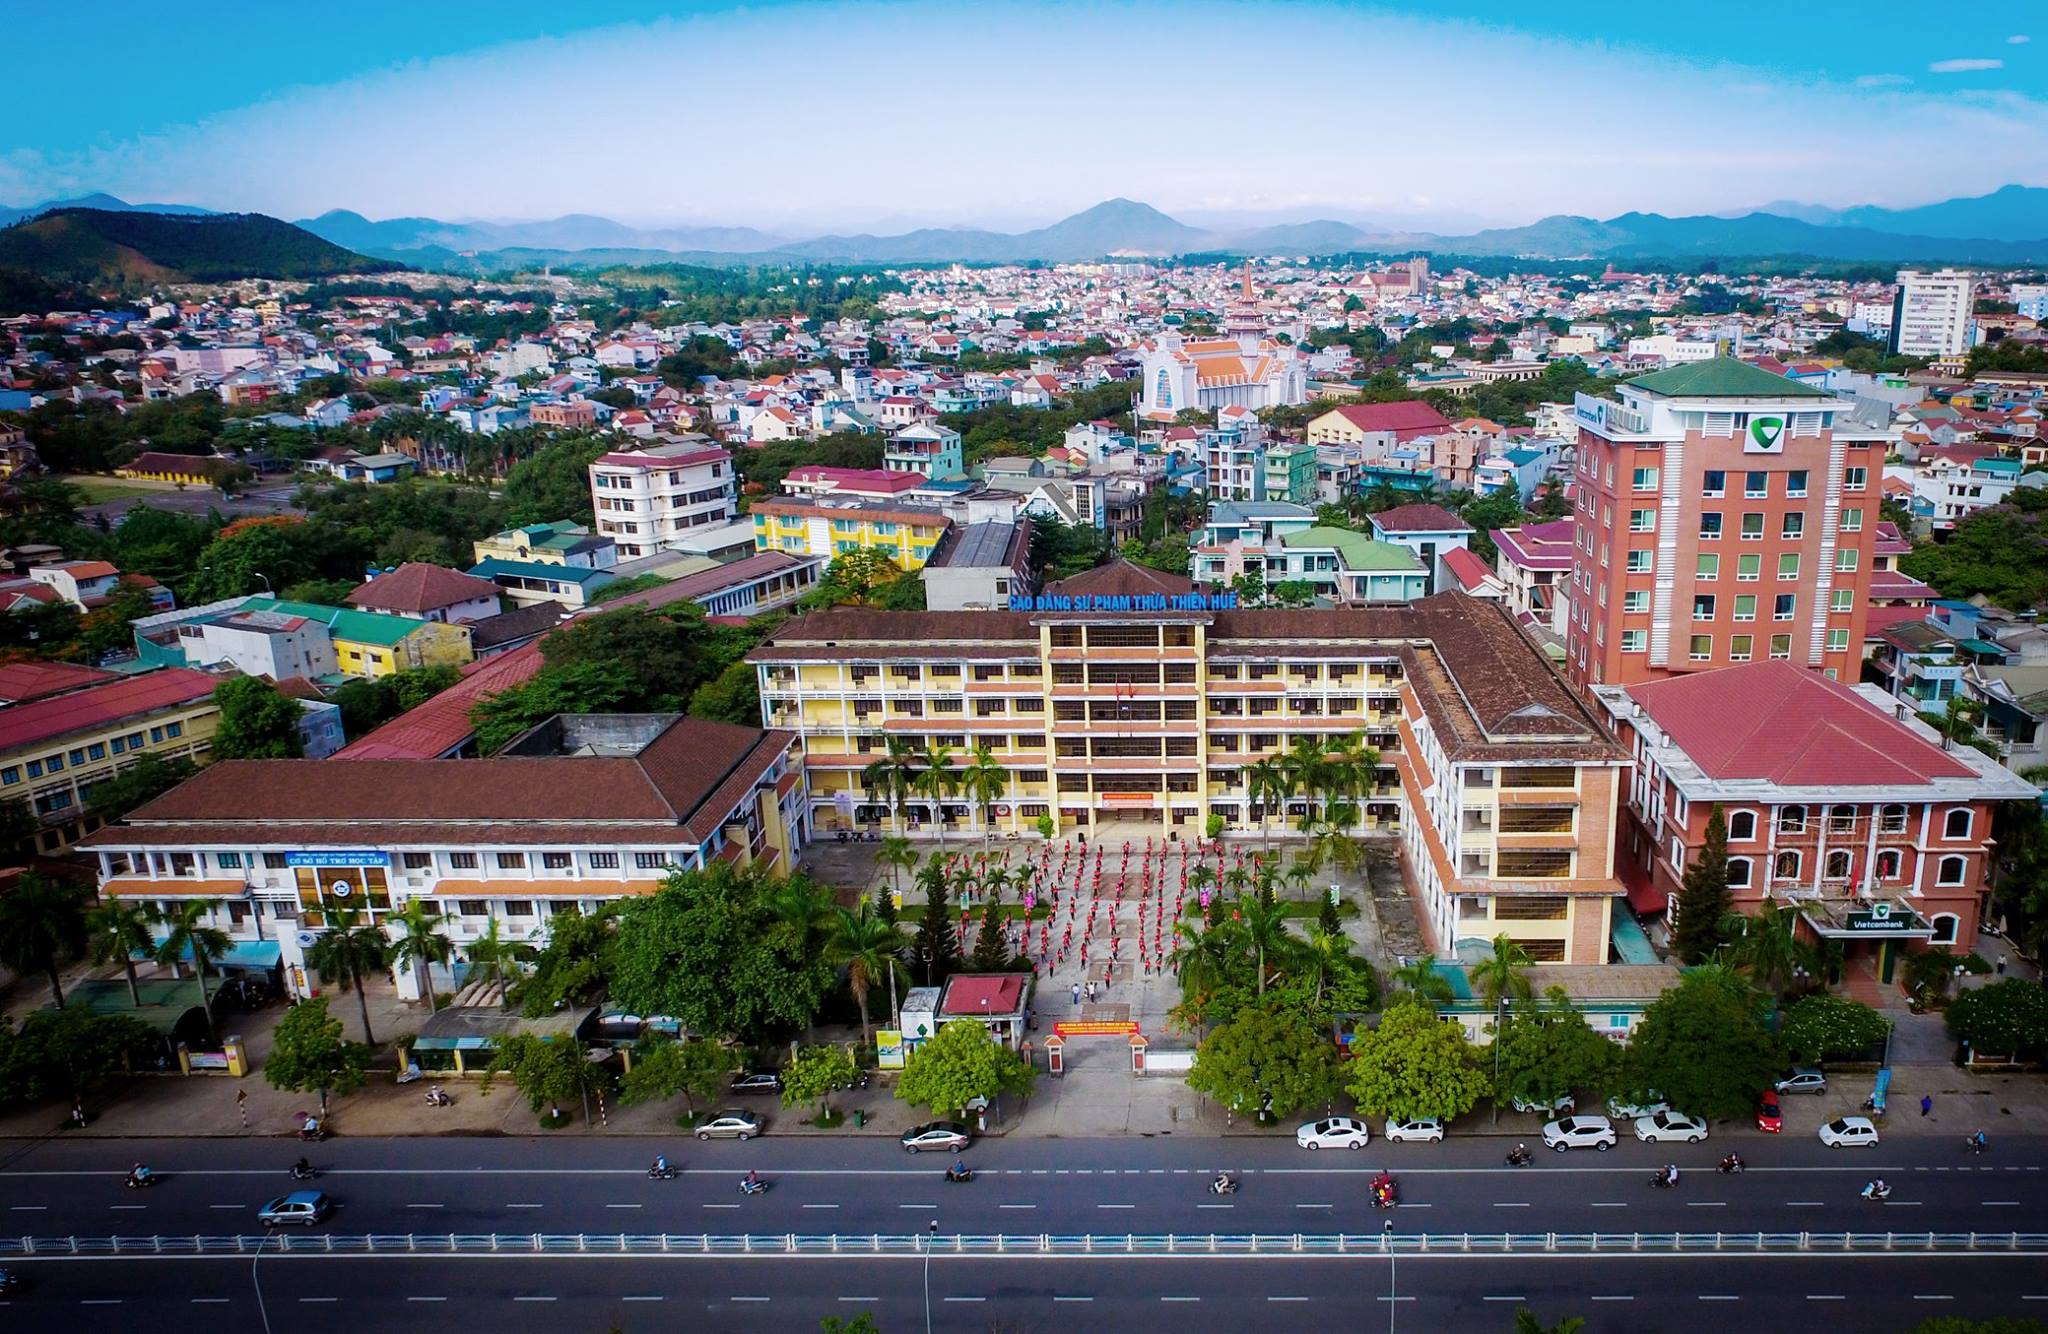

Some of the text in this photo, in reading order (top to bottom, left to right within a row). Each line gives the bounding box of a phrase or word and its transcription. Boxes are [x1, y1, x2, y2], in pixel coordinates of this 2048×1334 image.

[1008, 595, 1033, 610] CAO
[1171, 591, 1206, 609] THIÊN
[1211, 590, 1237, 609] HUẾ
[1854, 920, 1904, 928] Vietcombank
